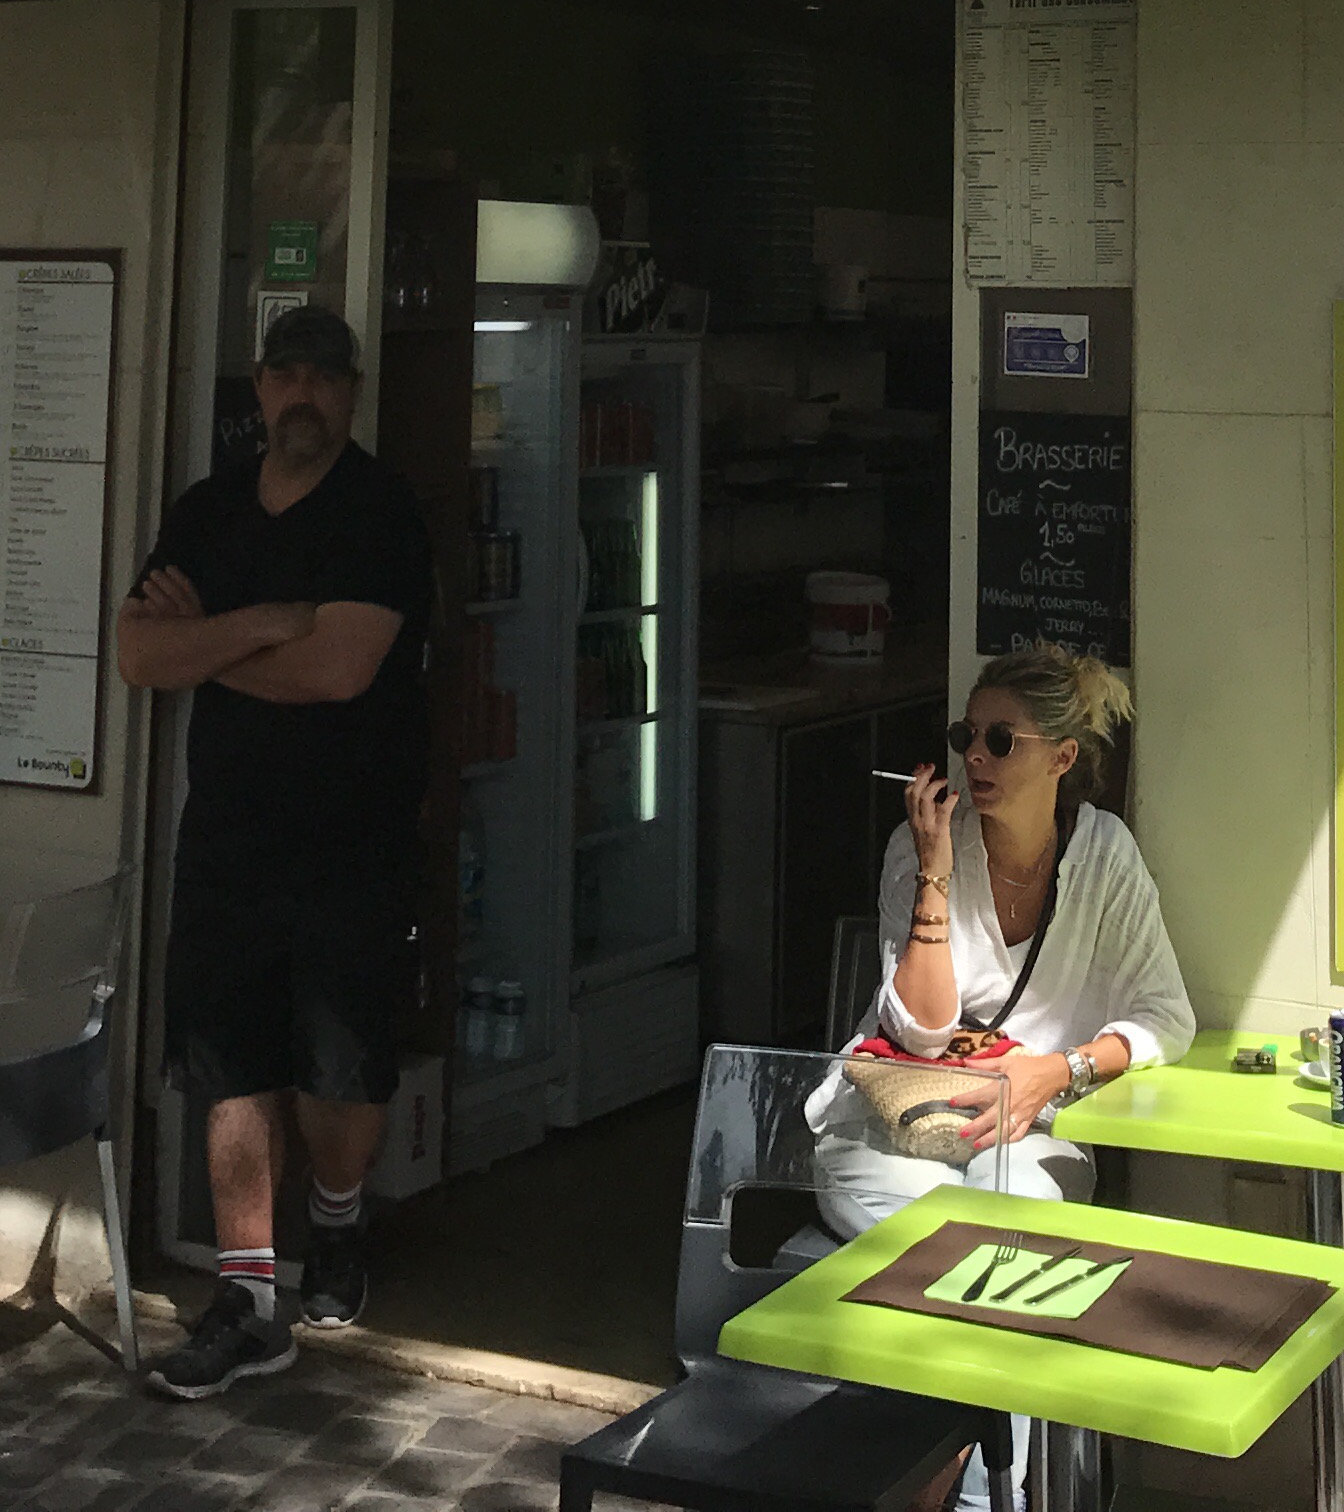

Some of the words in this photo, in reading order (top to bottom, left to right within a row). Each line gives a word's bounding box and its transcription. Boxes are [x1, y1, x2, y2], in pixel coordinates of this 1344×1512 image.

[994, 426, 1125, 472] BRASSERIE
[1038, 521, 1075, 548] 1,50
[1020, 560, 1085, 589] GLACES
[17, 755, 29, 767] Le
[31, 757, 69, 778] Bounty
